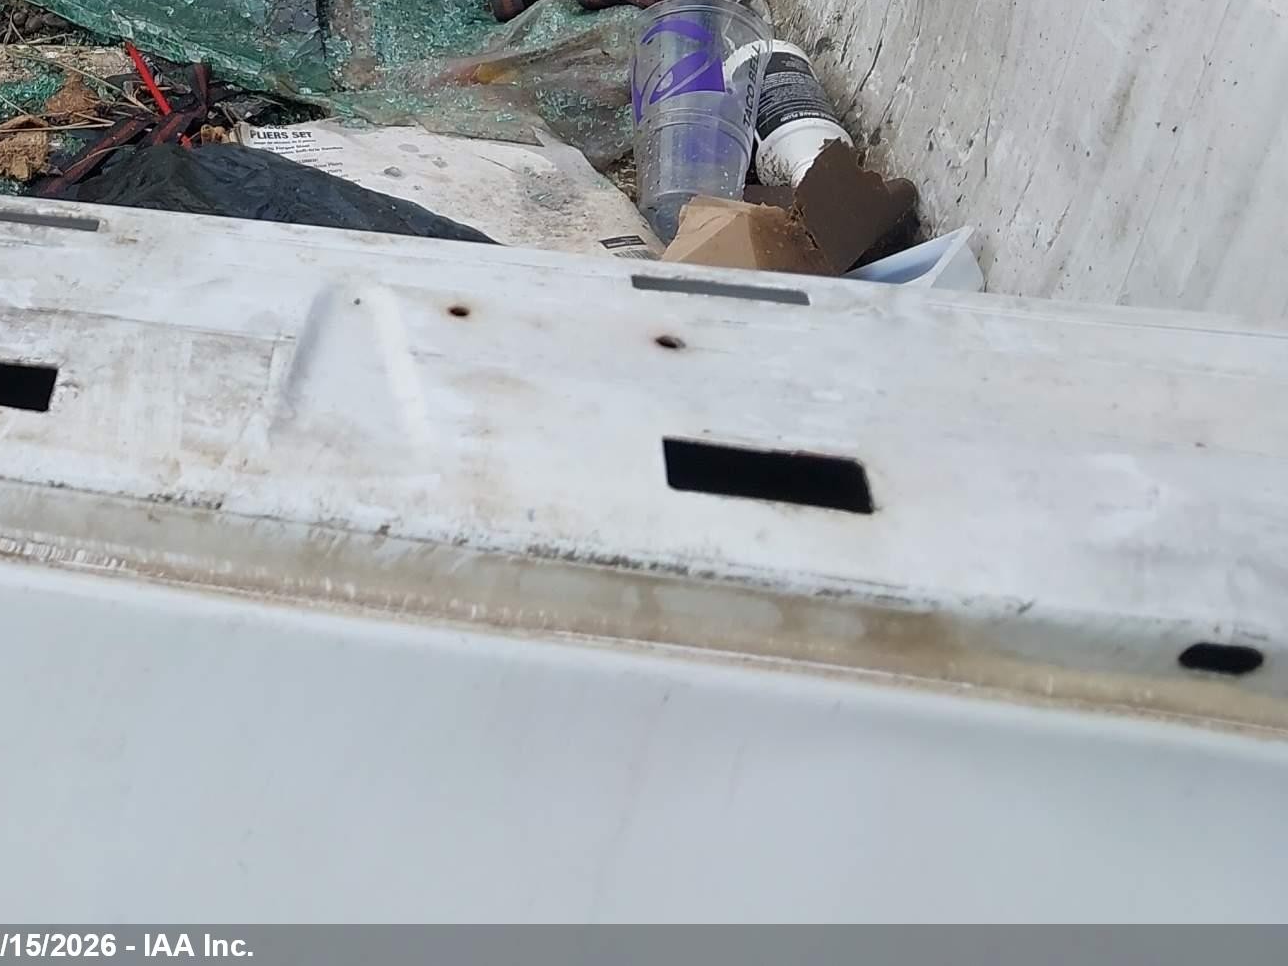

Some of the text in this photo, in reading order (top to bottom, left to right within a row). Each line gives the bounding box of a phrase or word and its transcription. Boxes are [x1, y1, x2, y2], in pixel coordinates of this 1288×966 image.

[743, 45, 761, 127] TACO BELL
[250, 130, 312, 139] PLIERS SET
